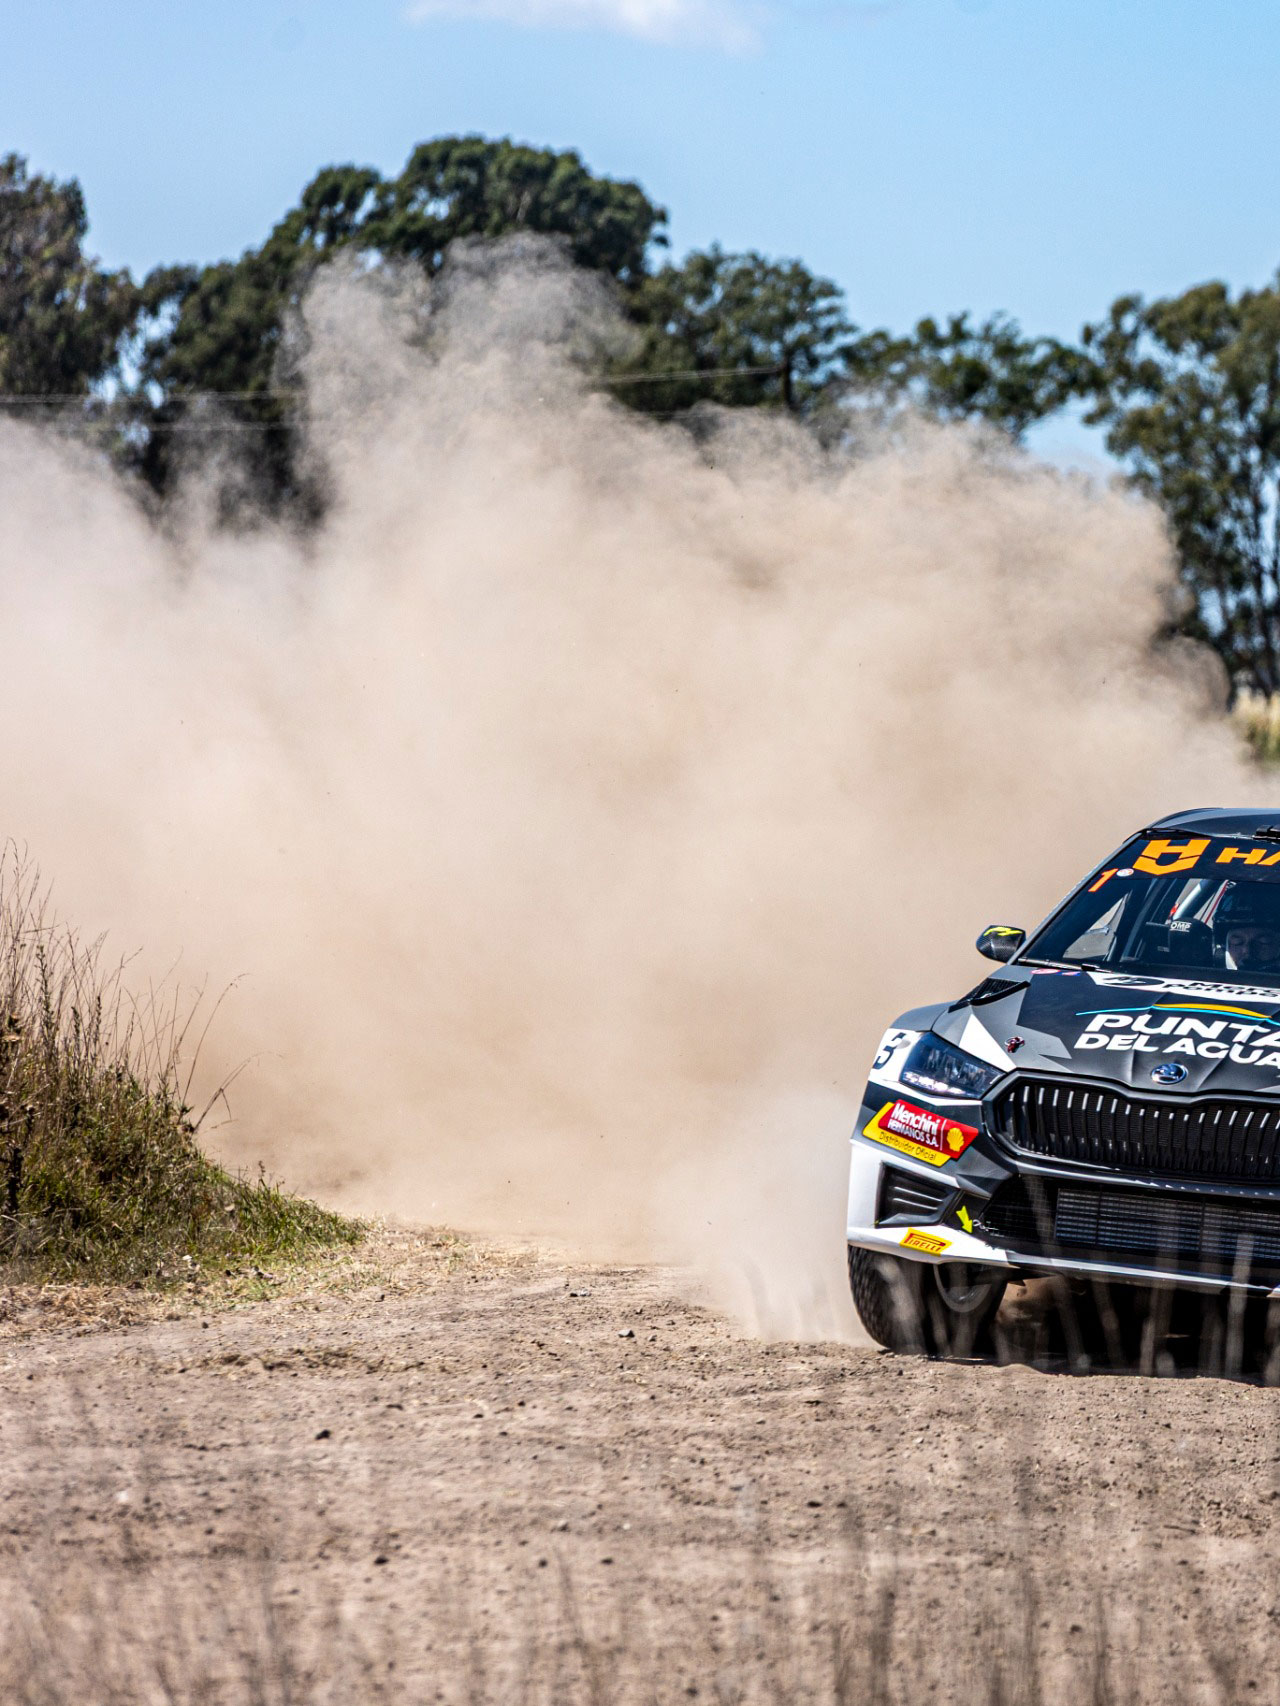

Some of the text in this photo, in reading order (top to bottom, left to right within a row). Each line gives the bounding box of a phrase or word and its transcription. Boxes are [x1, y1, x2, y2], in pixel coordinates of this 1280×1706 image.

[1170, 921, 1192, 931] OMP
[1073, 1033, 1159, 1052] DEL
[890, 1102, 940, 1135] Menchini
[888, 1118, 925, 1142] HERMANOS
[879, 1131, 915, 1152] Distribuidor
[904, 1232, 946, 1252] PIRELLI
